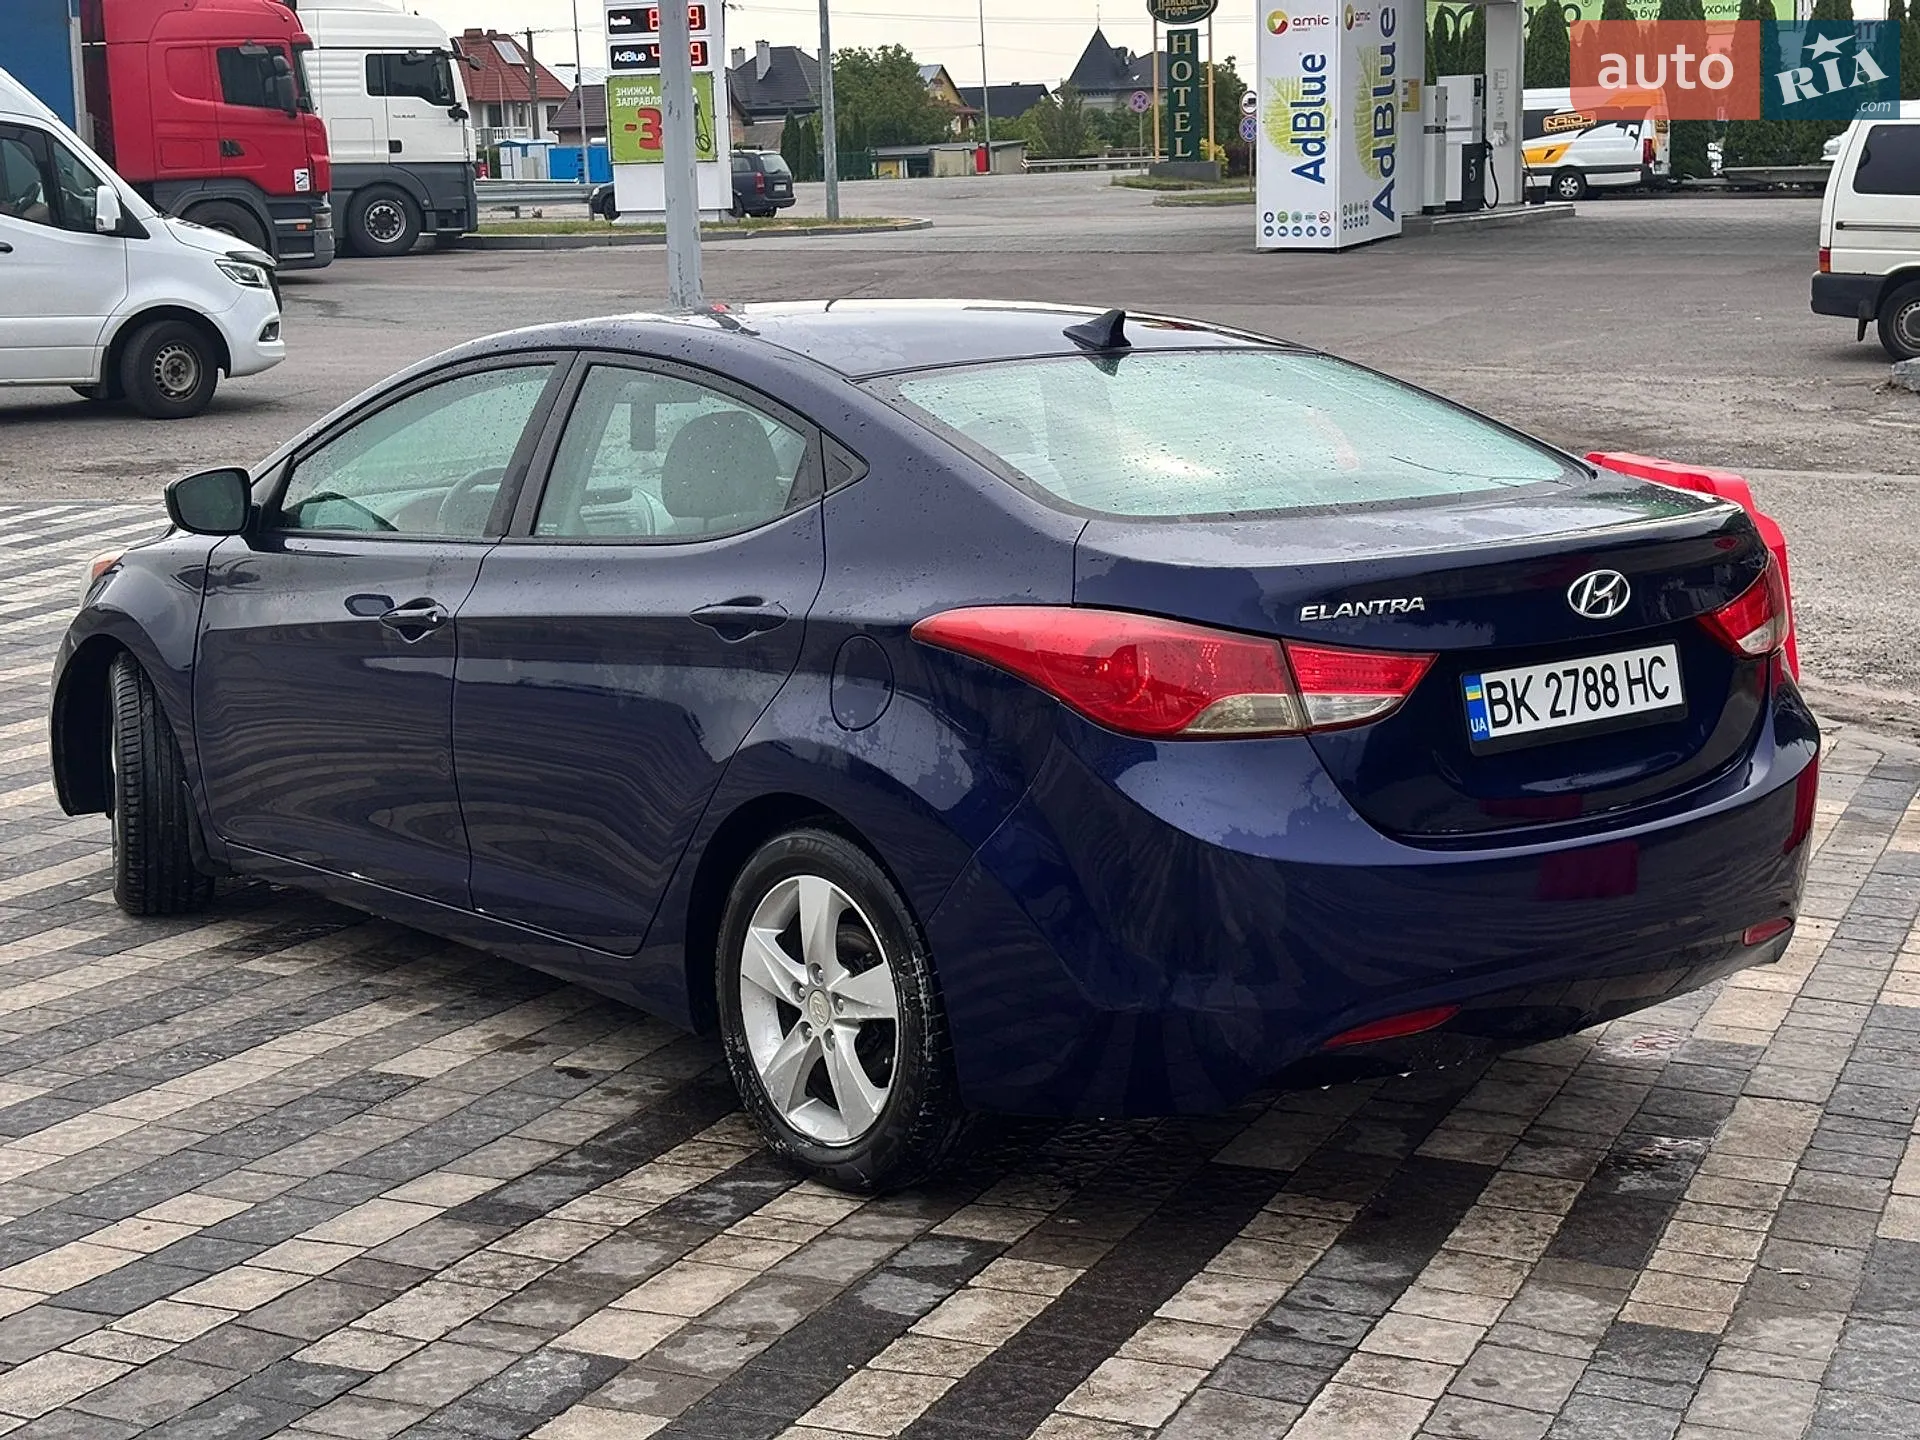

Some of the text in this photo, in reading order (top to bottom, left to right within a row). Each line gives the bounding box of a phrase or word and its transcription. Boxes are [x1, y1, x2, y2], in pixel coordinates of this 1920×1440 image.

[1292, 15, 1330, 26] amic
[614, 51, 647, 62] AdBlue
[615, 86, 654, 96] ЗНИЖКА
[1171, 34, 1192, 158] HOTEL
[1290, 53, 1327, 185] AdBlue
[1372, 7, 1396, 223] AdBlue
[1300, 597, 1425, 621] ELANTRA
[1485, 656, 1670, 729] BK 2788 HC
[1470, 718, 1488, 734] UA
